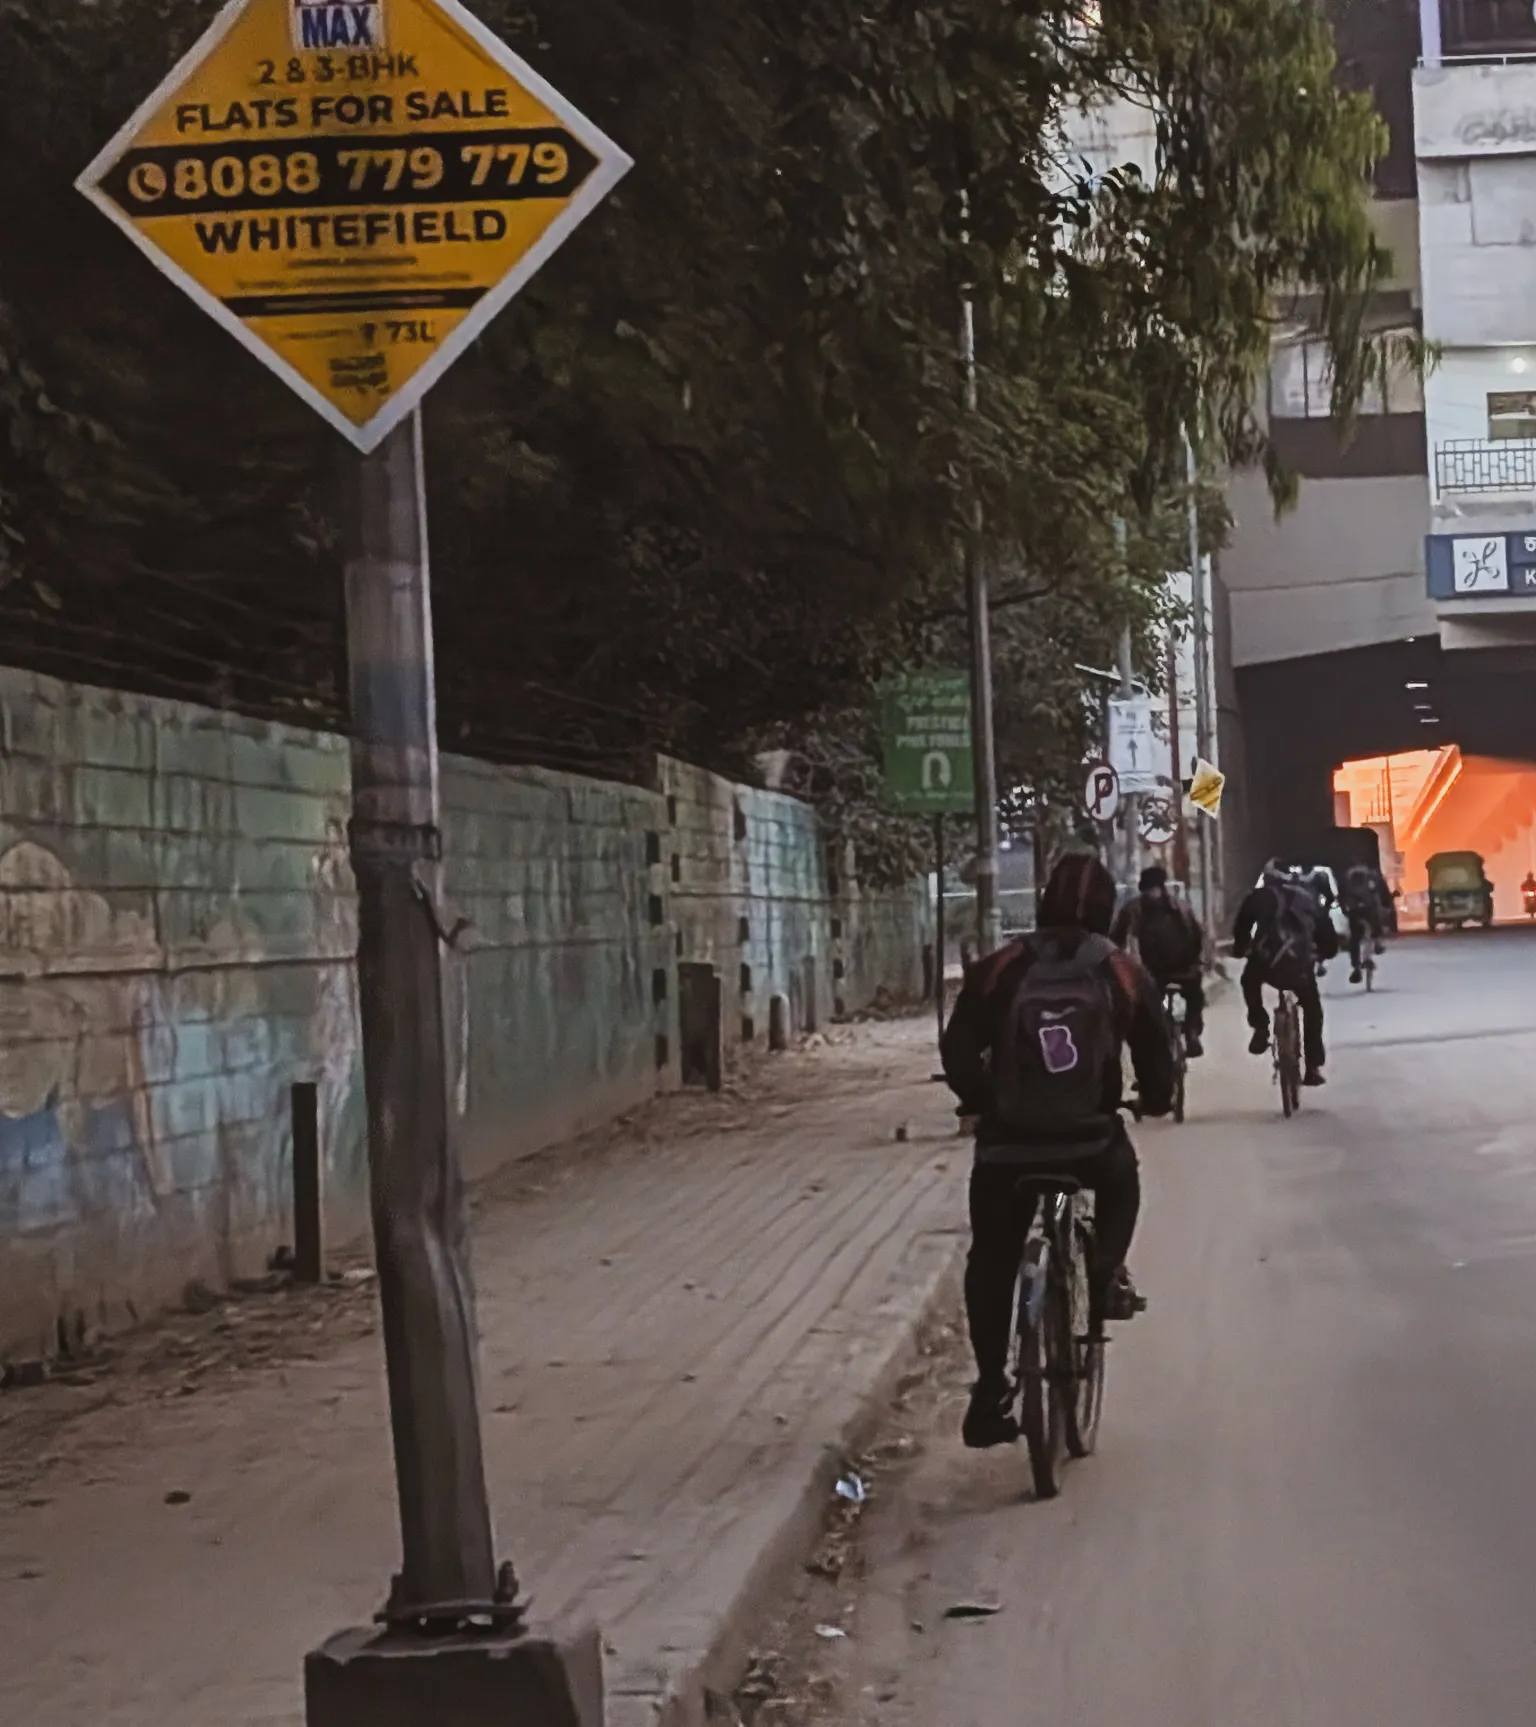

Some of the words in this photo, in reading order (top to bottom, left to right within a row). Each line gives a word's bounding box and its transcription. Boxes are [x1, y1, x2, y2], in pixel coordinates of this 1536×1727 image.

[302, 6, 372, 48] MAX
[258, 60, 276, 85] 2
[314, 51, 420, 82] 3-BHK
[175, 97, 298, 132] FLATS
[311, 94, 393, 126] FOR
[407, 89, 509, 121] SALE
[173, 152, 321, 199] 8088
[337, 146, 443, 191] 779
[460, 142, 569, 186] 779
[194, 209, 508, 253] WHITEFIELD
